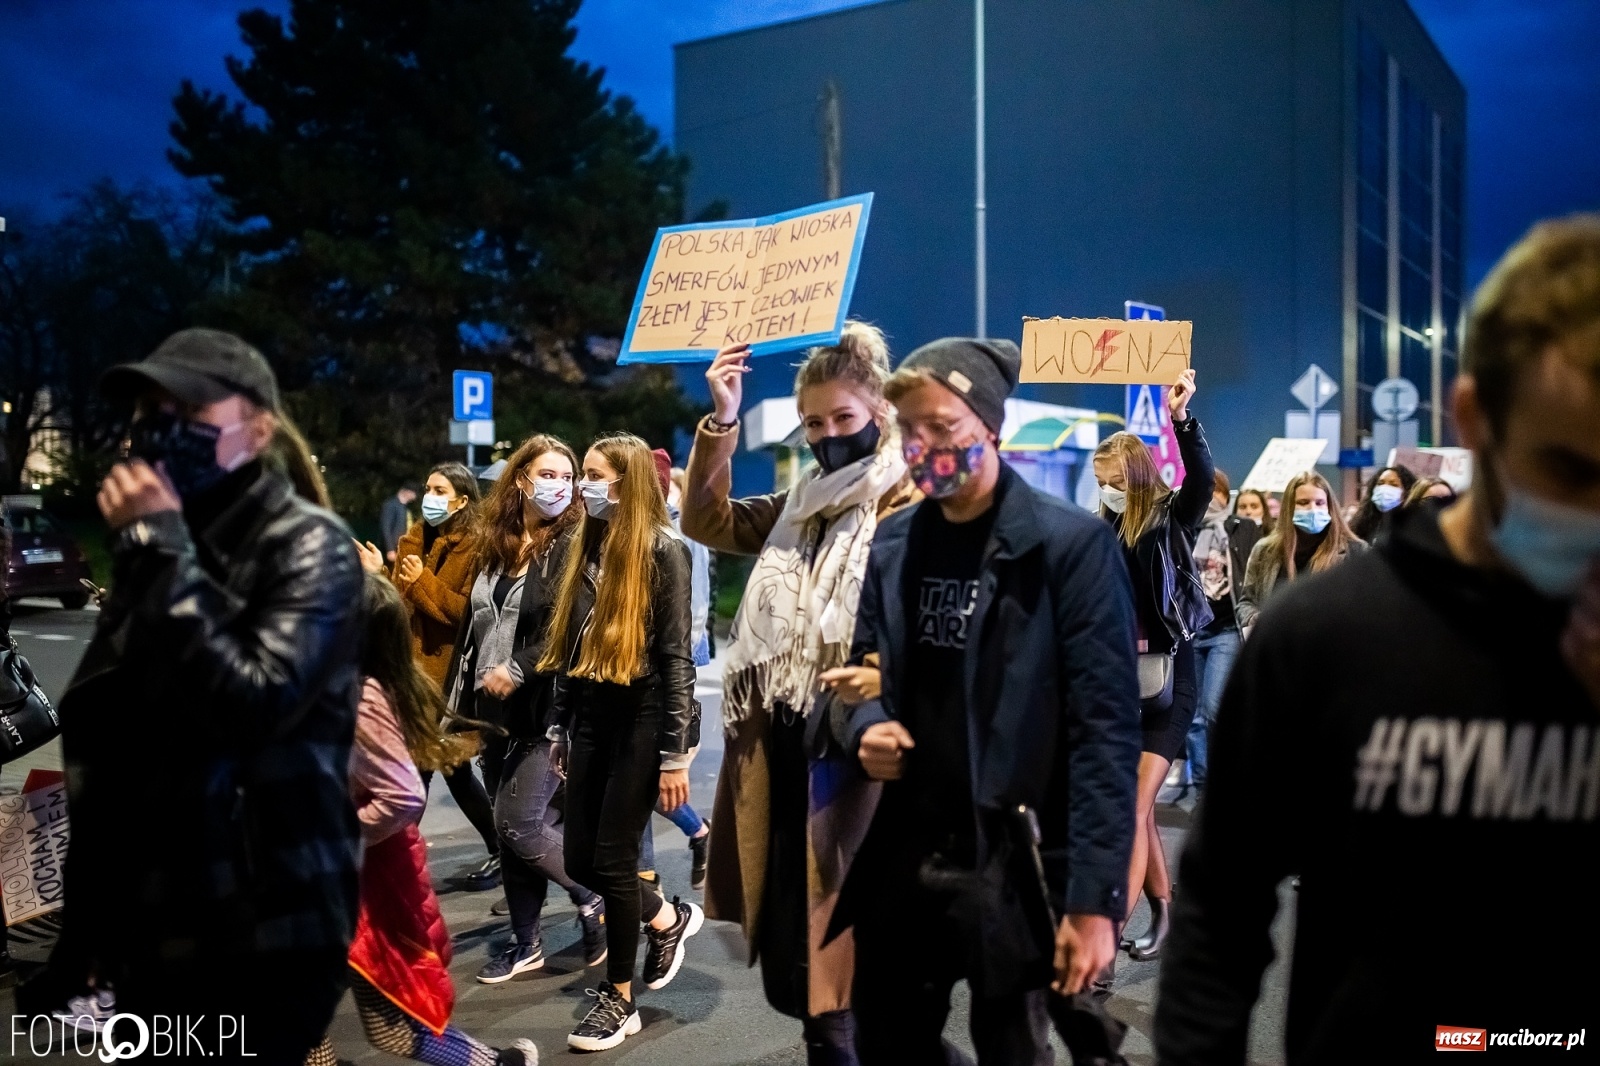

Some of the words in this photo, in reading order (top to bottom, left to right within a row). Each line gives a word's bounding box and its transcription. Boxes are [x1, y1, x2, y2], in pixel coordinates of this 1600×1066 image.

[662, 230, 744, 258] POLSKA
[747, 227, 780, 258] JAK
[790, 211, 852, 243] WIOSKA
[646, 264, 749, 296] SMERFÓW
[752, 251, 839, 295] JEDYNYM
[638, 301, 690, 328] ZŁEM
[696, 300, 746, 330] JEST
[751, 280, 838, 315] CZŁOWIEK
[687, 327, 707, 346] Z
[463, 377, 485, 415] P
[26, 822, 64, 907] KOCHAM
